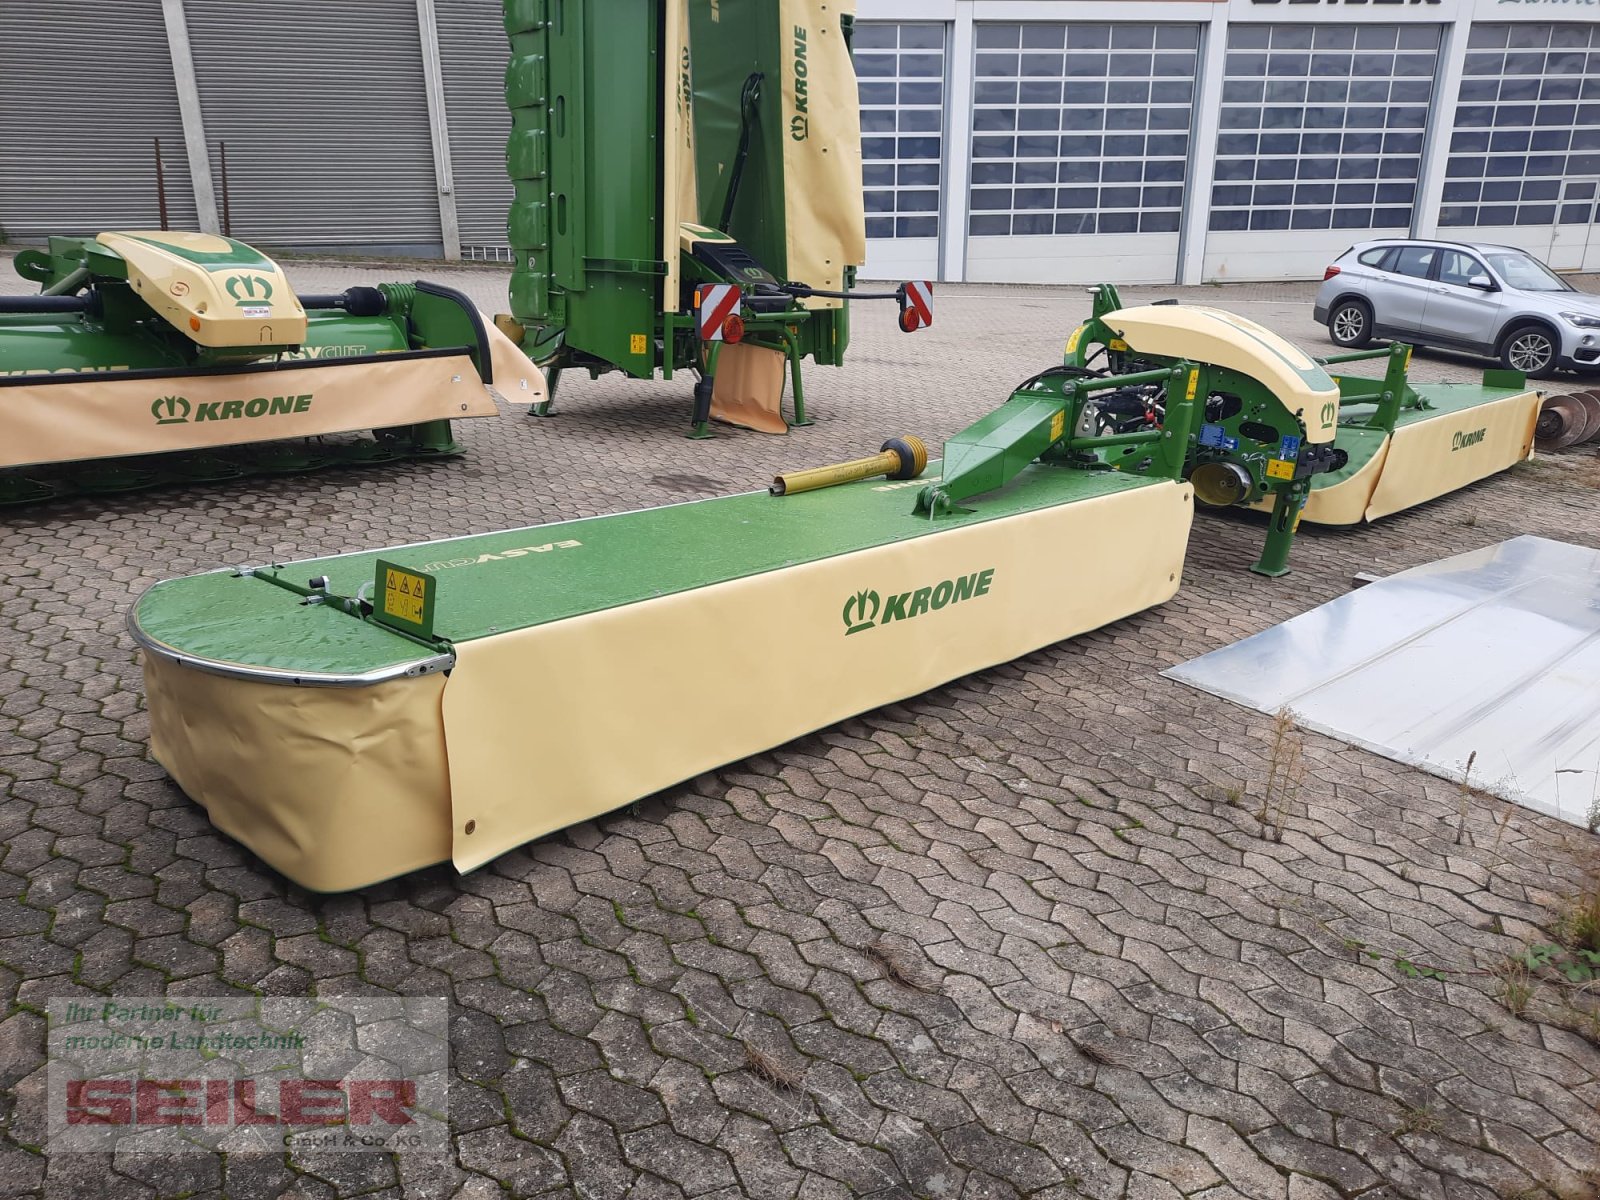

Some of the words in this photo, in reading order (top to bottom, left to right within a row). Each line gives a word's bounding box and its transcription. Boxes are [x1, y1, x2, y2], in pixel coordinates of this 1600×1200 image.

[794, 25, 808, 115] KRONE
[194, 394, 313, 422] KRONE
[1459, 427, 1487, 449] KRONE
[880, 568, 995, 625] KRONE
